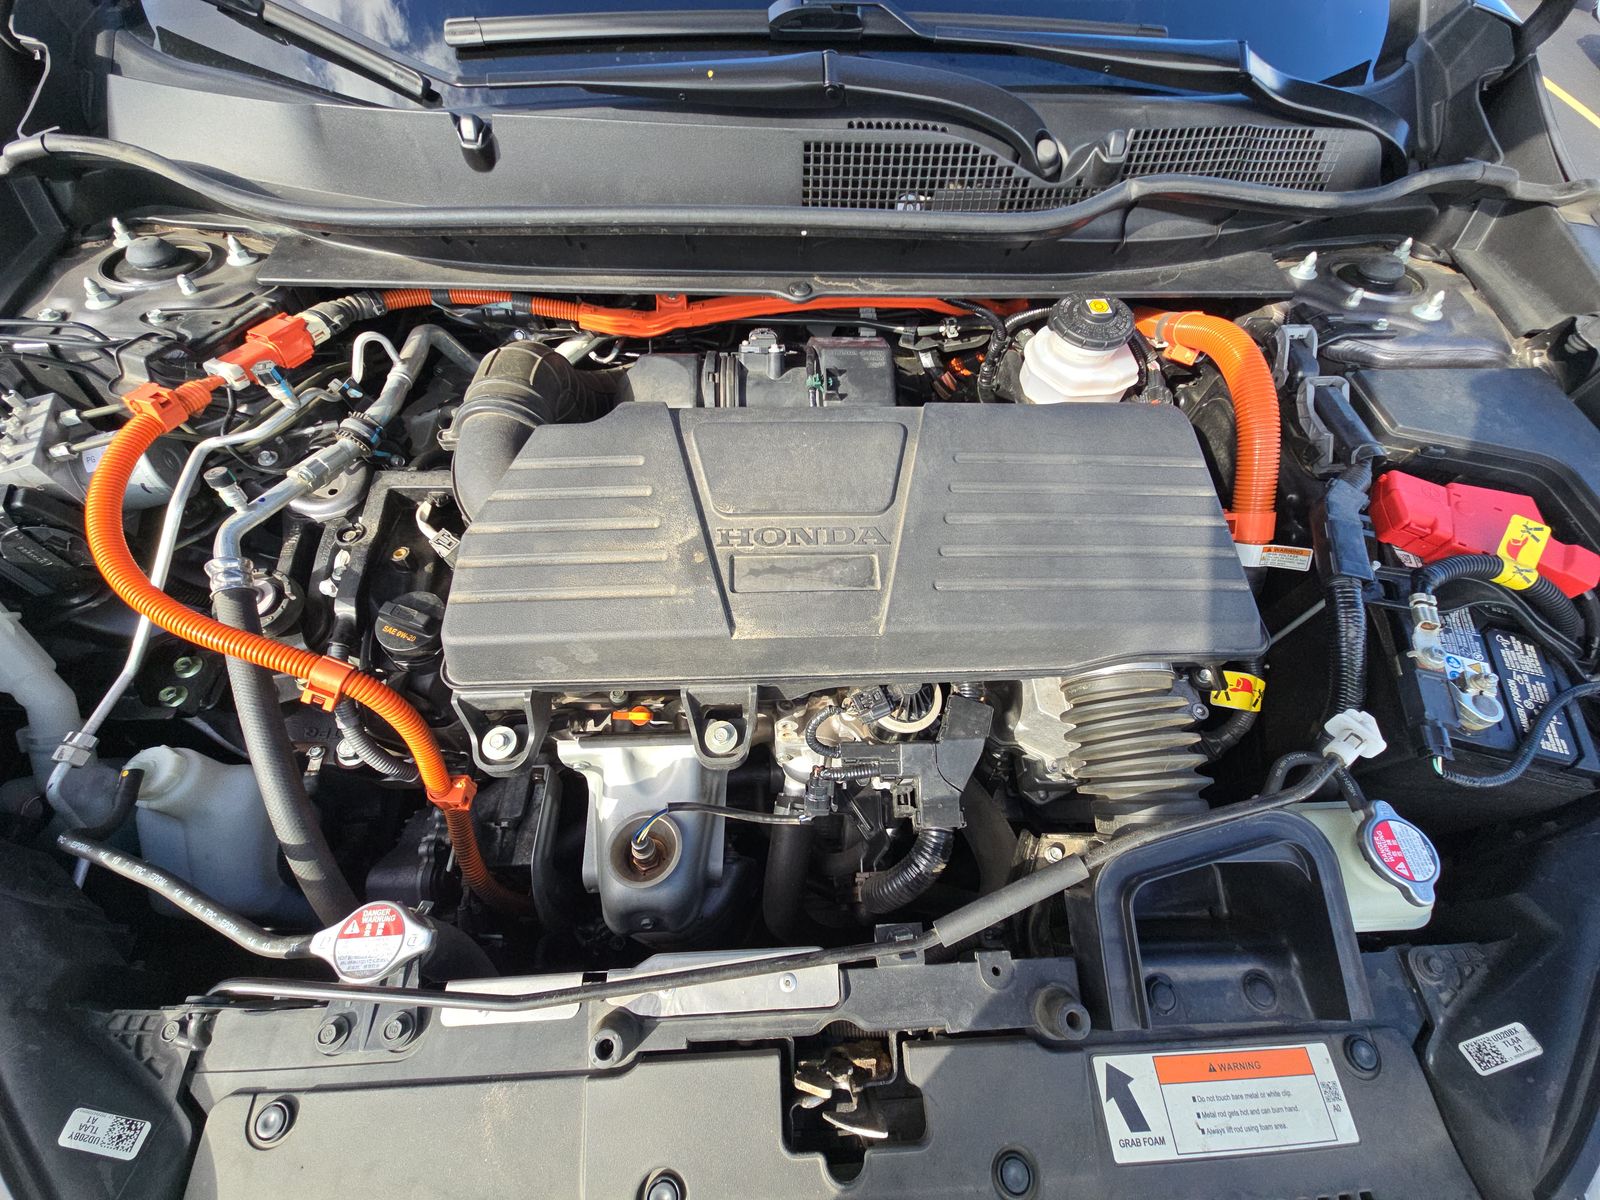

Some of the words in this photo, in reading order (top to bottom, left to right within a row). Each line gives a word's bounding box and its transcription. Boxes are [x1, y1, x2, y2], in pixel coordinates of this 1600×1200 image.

[716, 526, 892, 547] HONDA
[382, 625, 397, 635] SAE
[396, 630, 417, 642] 0W-20
[361, 914, 396, 923] WARNING
[362, 908, 391, 917] DANGER
[1491, 1027, 1520, 1042] UD20BX
[1503, 1036, 1522, 1048] TLAA
[1513, 1045, 1525, 1053] A1
[1218, 1060, 1262, 1072] WARNING
[1196, 1095, 1206, 1103] Do
[1206, 1094, 1215, 1102] not
[1215, 1092, 1231, 1101] touch
[1231, 1091, 1247, 1100] bare
[1248, 1090, 1260, 1099] metal
[1267, 1089, 1280, 1098] white
[1281, 1089, 1292, 1098] clip.
[1201, 1110, 1217, 1119] Metal
[1217, 1109, 1227, 1117] rod
[1227, 1109, 1239, 1119] gets
[1240, 1108, 1249, 1116] hot
[1250, 1107, 1261, 1115] and
[1271, 1106, 1284, 1114] burn
[85, 1115, 99, 1125] A1
[78, 1123, 99, 1135] TLAA
[1206, 1126, 1226, 1135] Always
[1234, 1124, 1244, 1133] rod
[1244, 1124, 1259, 1133] using
[1259, 1123, 1273, 1131] foam
[1273, 1122, 1288, 1130] area.
[67, 1131, 101, 1146] UD20BY
[1118, 1138, 1142, 1148] GRAB
[1142, 1136, 1166, 1147] FOAM
